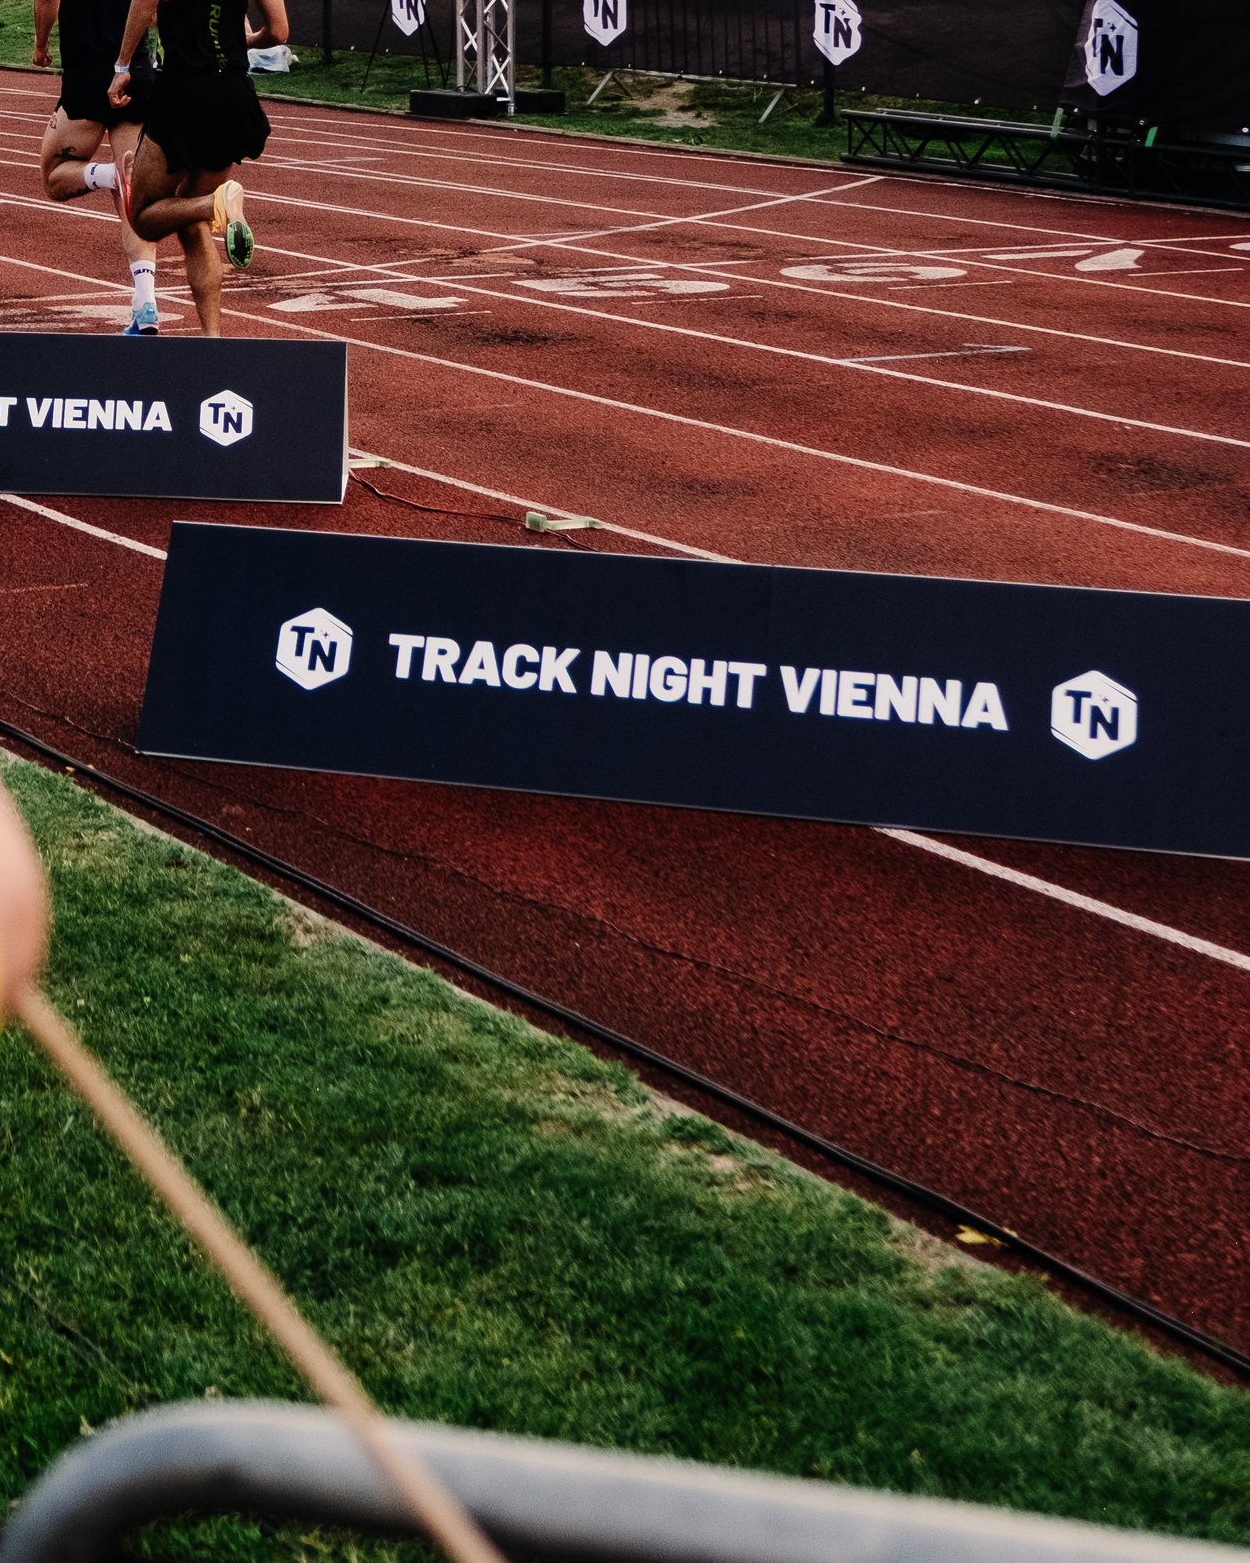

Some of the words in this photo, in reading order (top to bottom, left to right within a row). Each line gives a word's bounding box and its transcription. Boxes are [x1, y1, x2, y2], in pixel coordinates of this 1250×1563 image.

[818, 2, 853, 49] TN
[25, 397, 173, 432] VIENNA
[208, 403, 242, 433] TN
[291, 626, 337, 672] TN
[388, 633, 581, 694] TRACK
[590, 650, 768, 709] NIGHT
[779, 665, 1009, 731] VIENNA
[1066, 690, 1119, 740] TN
